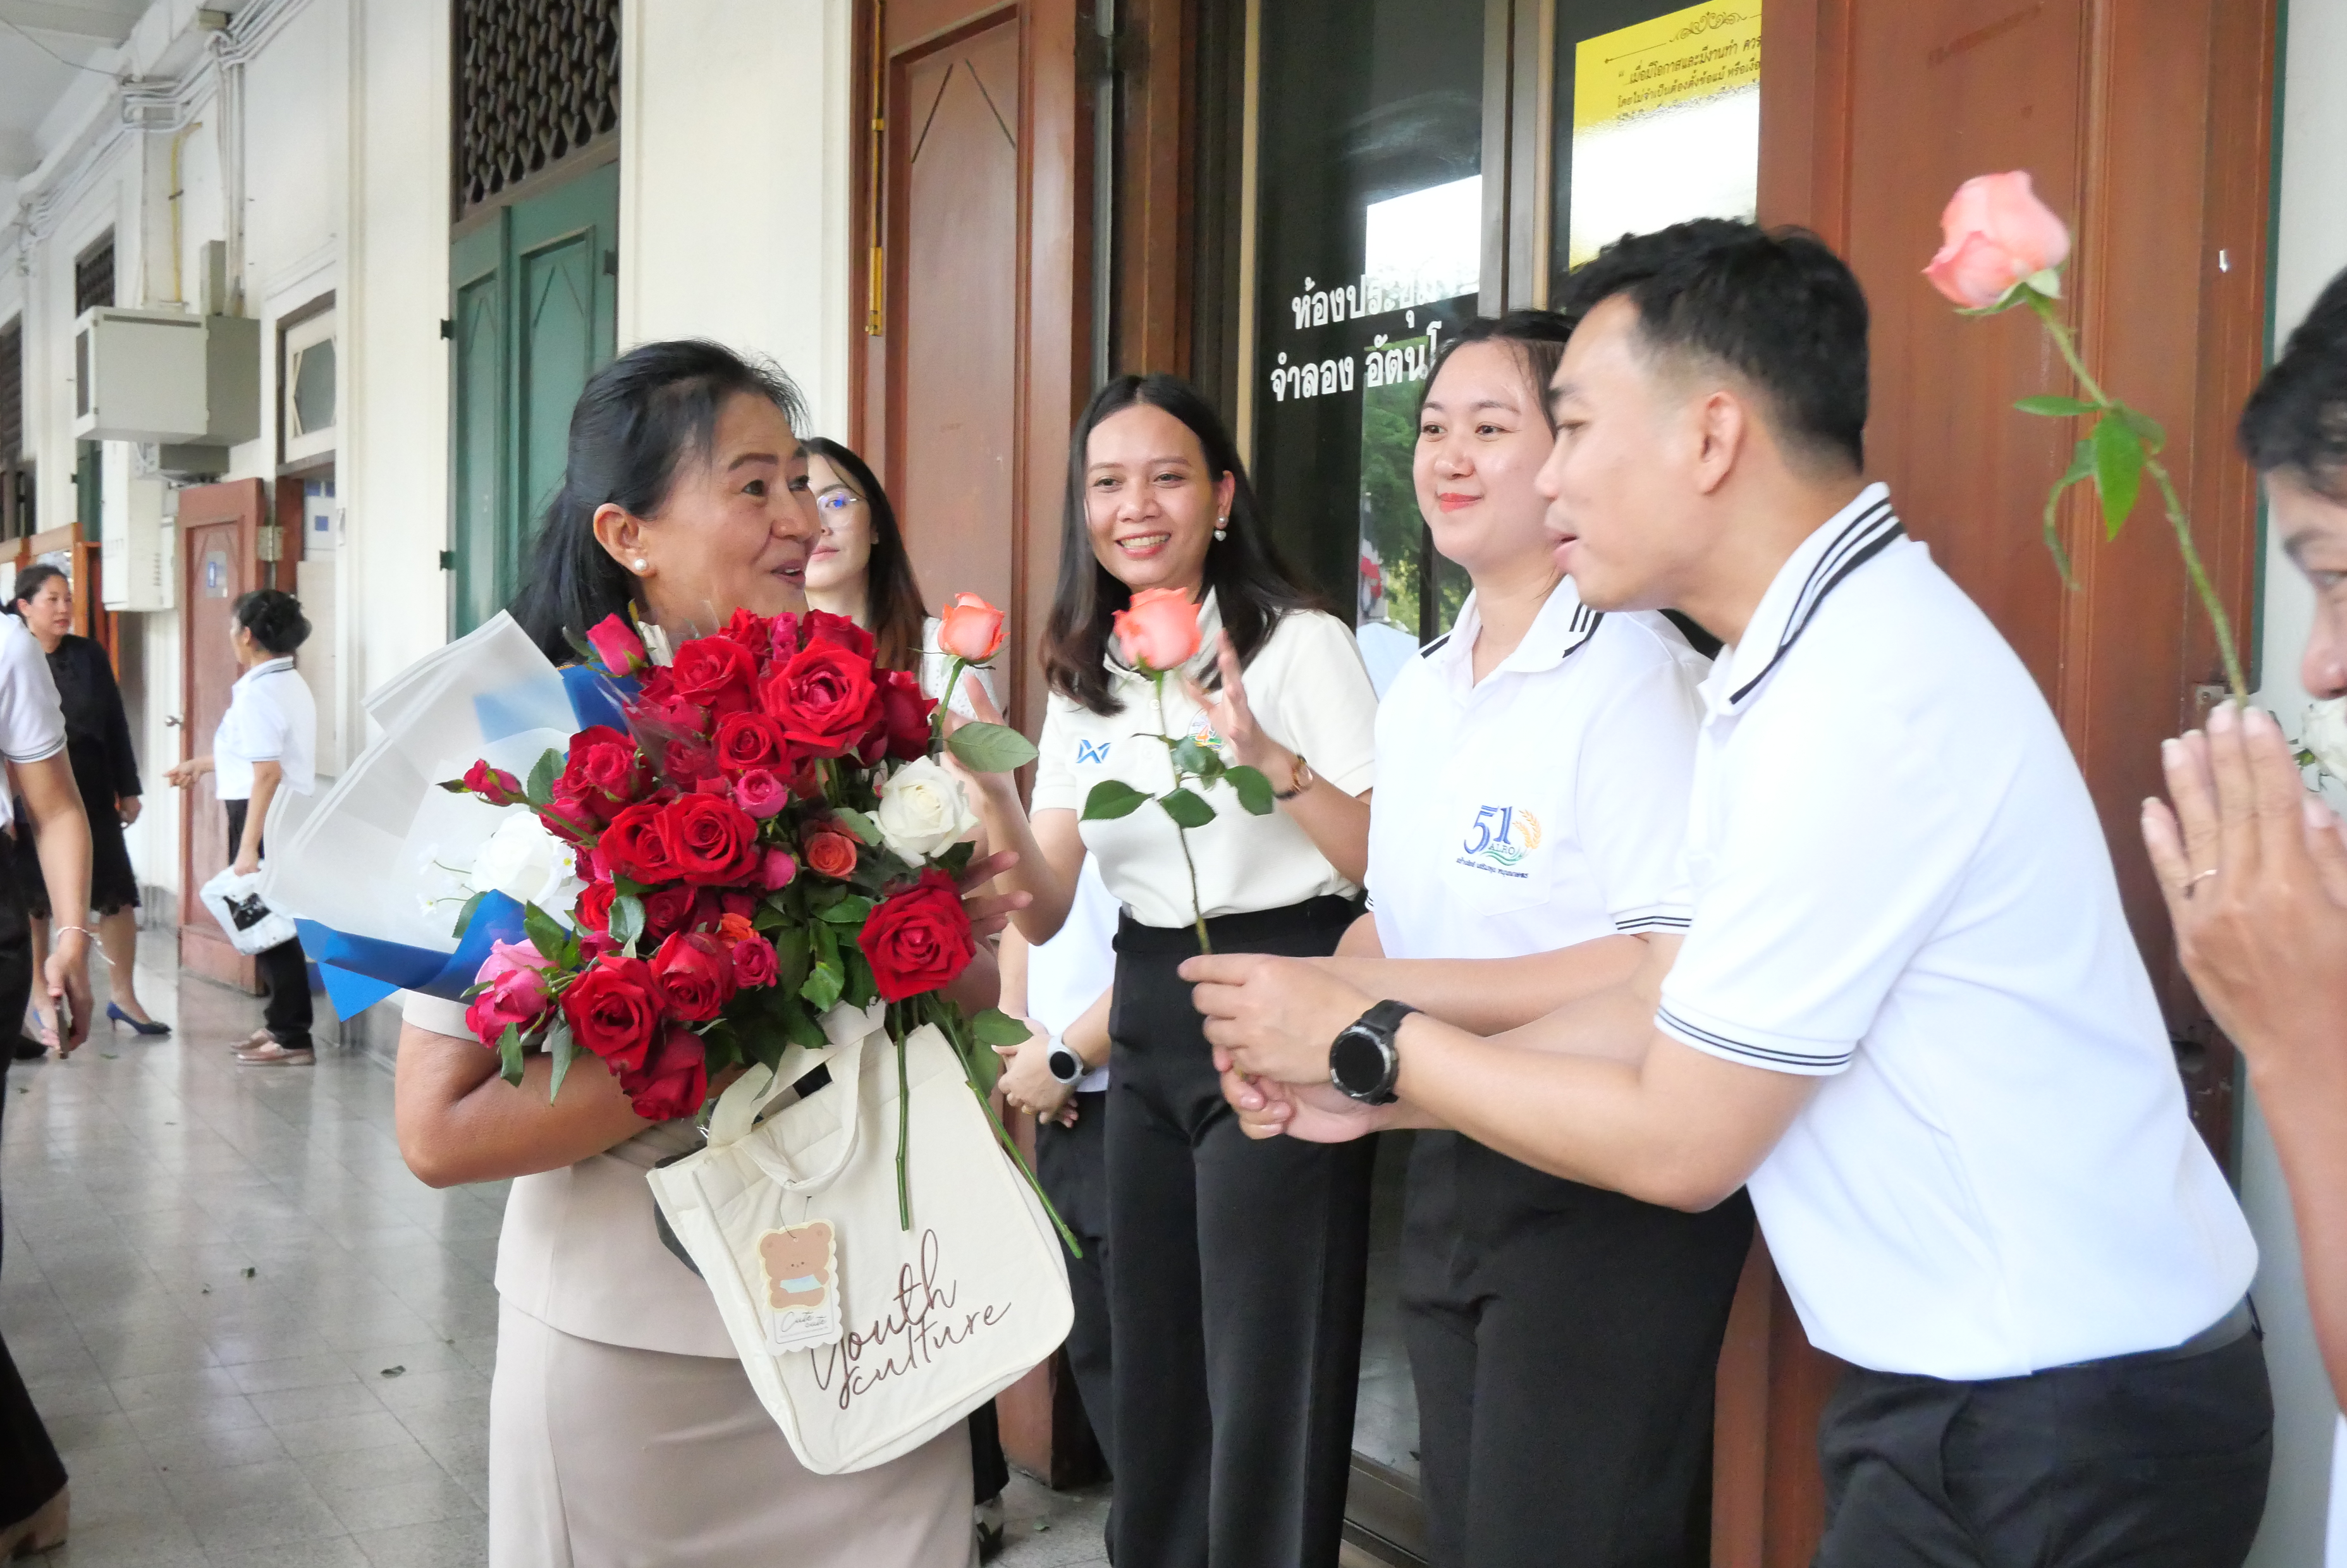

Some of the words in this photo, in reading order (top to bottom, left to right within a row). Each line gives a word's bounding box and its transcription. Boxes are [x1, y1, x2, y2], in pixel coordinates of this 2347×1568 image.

[1270, 352, 1354, 402] จำลอง
[1464, 805, 1513, 854] 51
[1488, 843, 1516, 855] ALRO
[811, 1228, 957, 1411] Youth
